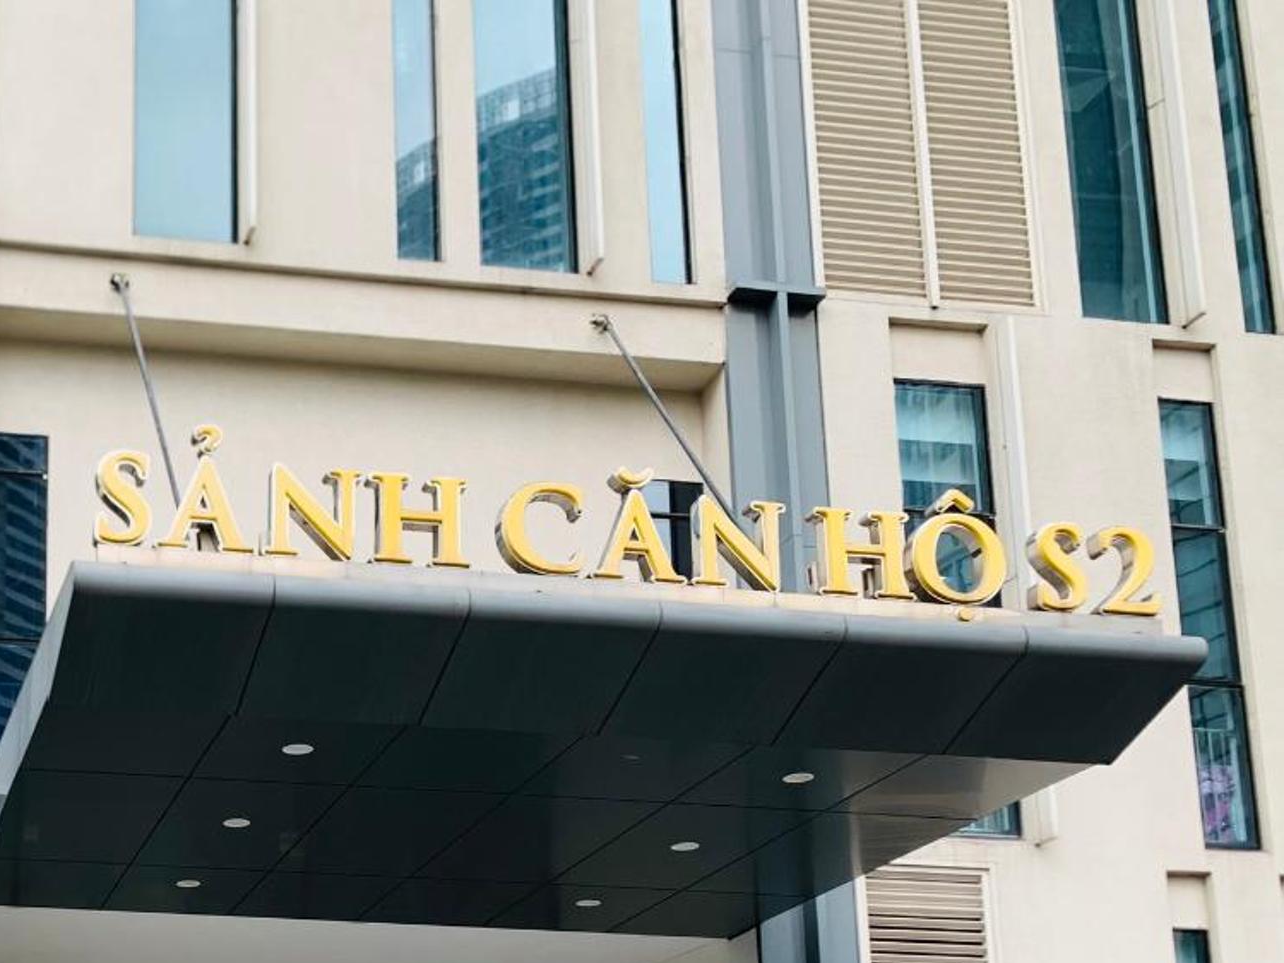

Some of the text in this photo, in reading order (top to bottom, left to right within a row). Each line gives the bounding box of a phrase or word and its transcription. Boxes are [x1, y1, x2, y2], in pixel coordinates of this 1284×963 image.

[93, 423, 1163, 622] SẢNH CĂN HỘ S2
